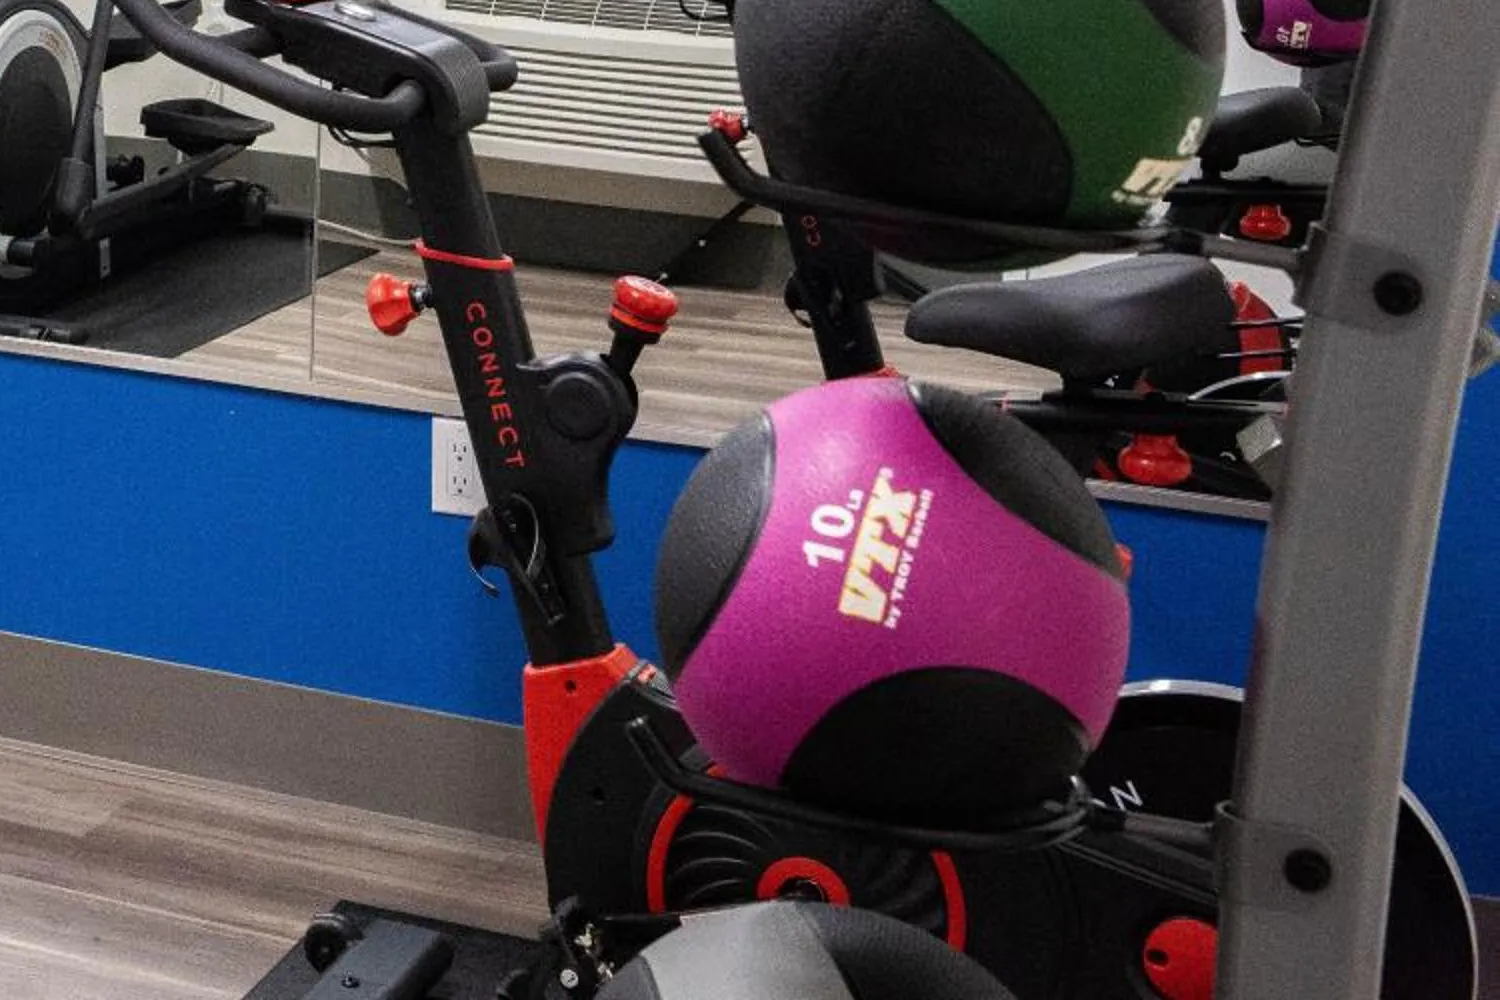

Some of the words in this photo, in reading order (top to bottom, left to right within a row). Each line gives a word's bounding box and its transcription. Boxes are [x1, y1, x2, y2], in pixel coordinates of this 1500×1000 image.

[467, 302, 525, 468] CONNECT
[837, 475, 917, 623] VTX
[891, 550, 914, 601] TROY
